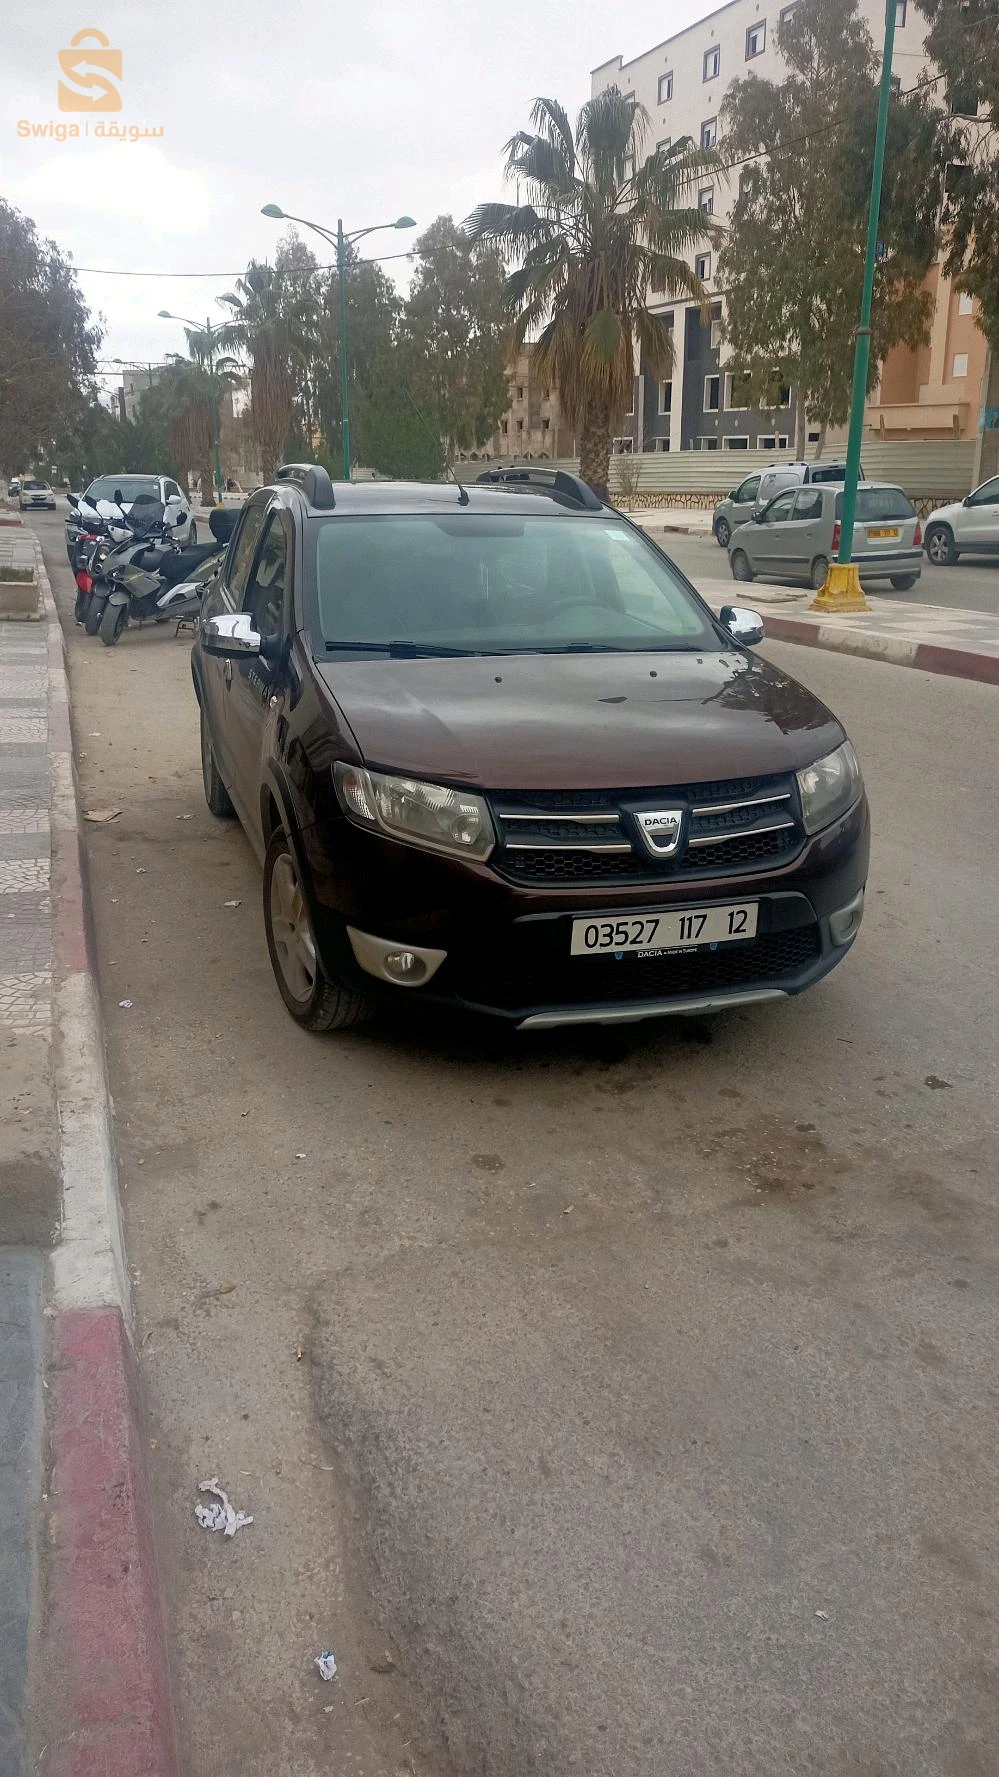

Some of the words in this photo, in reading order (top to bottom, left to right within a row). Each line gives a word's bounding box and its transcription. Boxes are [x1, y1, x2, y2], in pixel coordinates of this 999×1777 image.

[644, 816, 677, 826] DACIA
[584, 919, 660, 949] 03527
[678, 914, 708, 940] 117
[727, 910, 748, 935] 12
[637, 950, 663, 958] DACIA
